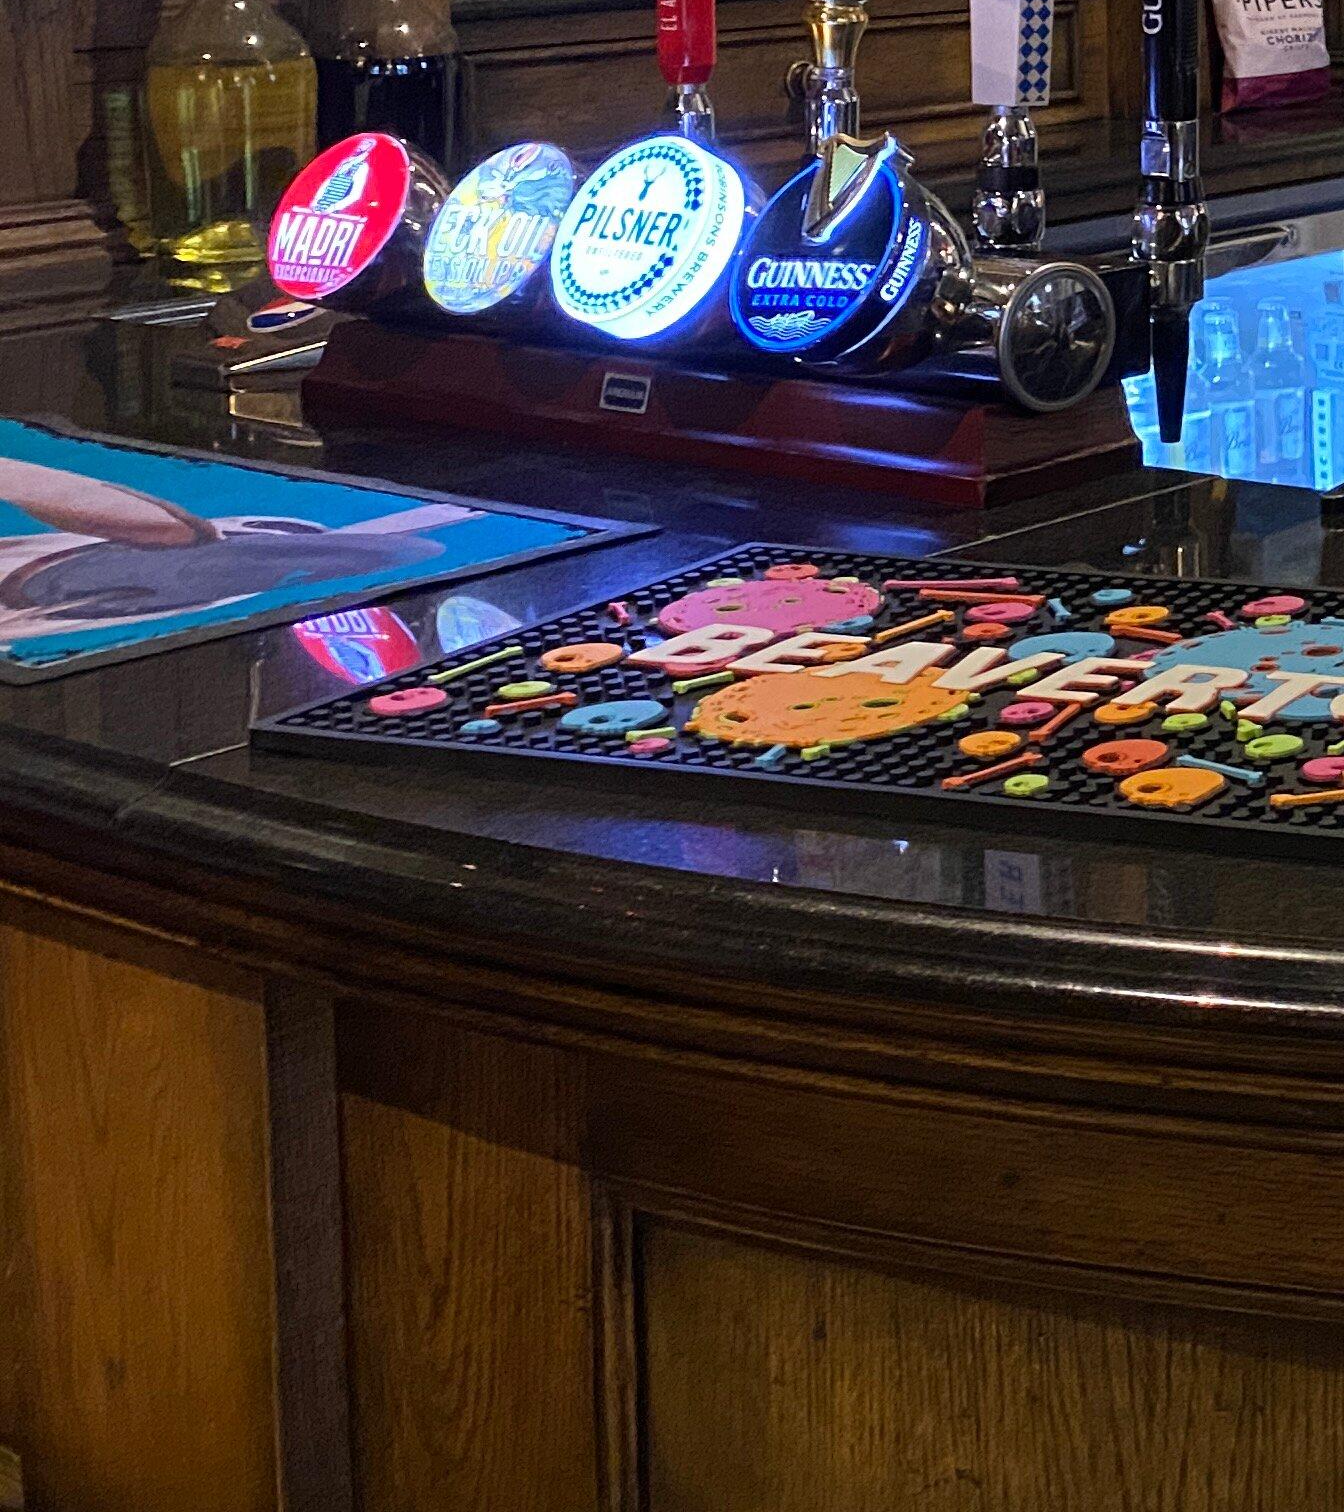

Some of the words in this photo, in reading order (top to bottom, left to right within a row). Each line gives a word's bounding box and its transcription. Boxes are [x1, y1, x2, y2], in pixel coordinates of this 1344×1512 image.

[660, 15, 678, 32] EL
[1266, 33, 1314, 46] CHORIZ
[429, 205, 506, 256] ECK
[572, 203, 683, 249] PILSNER
[747, 257, 876, 290] GUINNESS
[879, 217, 922, 302] GUINNESS
[645, 251, 709, 318] BREWERY
[752, 294, 799, 307] EXTRA
[805, 293, 849, 307] COLD
